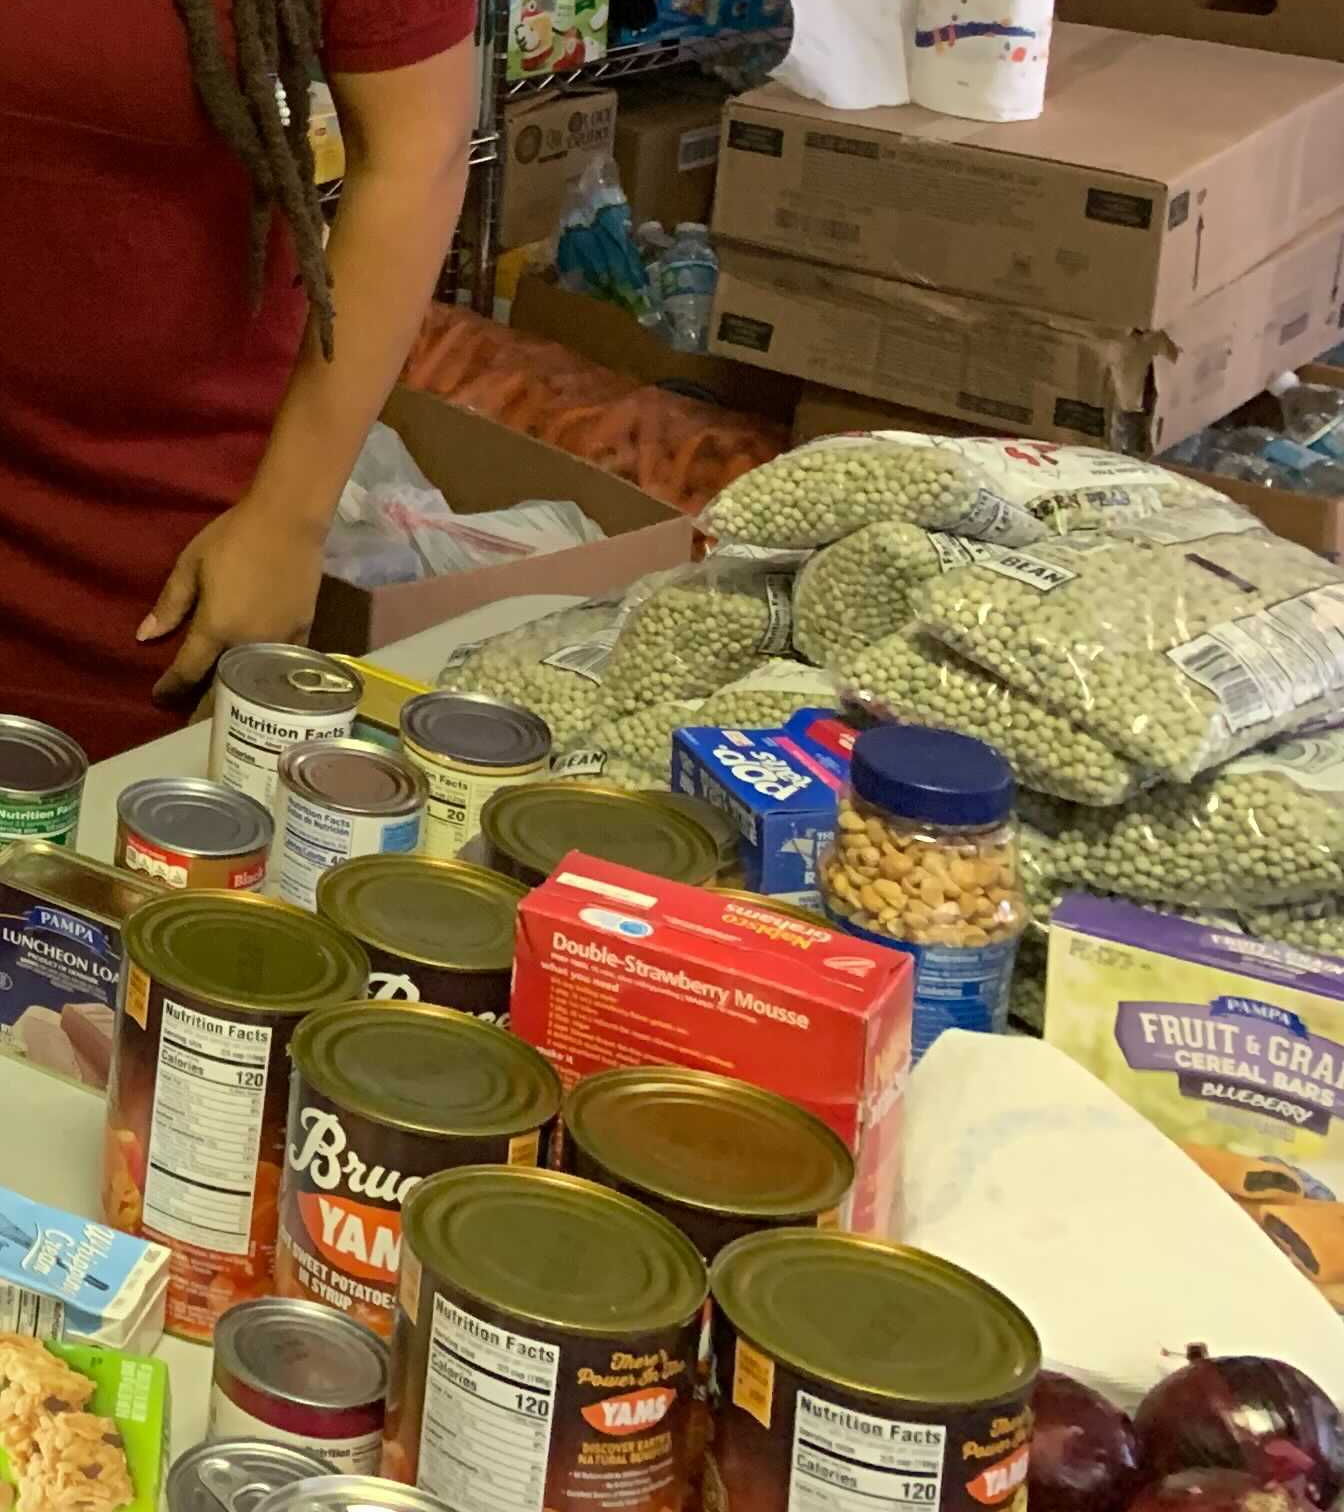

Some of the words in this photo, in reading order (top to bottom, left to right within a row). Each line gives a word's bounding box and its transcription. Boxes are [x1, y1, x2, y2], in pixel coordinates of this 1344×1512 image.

[230, 705, 299, 740] Nutrition
[305, 726, 345, 741] Facts
[439, 774, 469, 791] Facts
[323, 813, 351, 829] Facts
[446, 808, 465, 822] 20
[41, 911, 94, 943] PAMPA
[721, 914, 812, 951] Nabisco
[725, 902, 832, 944] Grahams
[2, 927, 89, 973] LUNCHEON
[540, 961, 567, 978] what
[570, 970, 587, 986] you
[589, 975, 620, 993] need
[552, 931, 730, 1007] Double-Strawberry
[734, 988, 811, 1030] Mousse
[165, 1002, 223, 1036] Nutrition
[228, 1026, 269, 1043] Facts
[1227, 997, 1291, 1026] PAMPA
[1140, 1012, 1240, 1055] FRUIT
[161, 1048, 204, 1076] Calories
[236, 1070, 263, 1088] 120
[1174, 1050, 1266, 1085] CEREAL
[1272, 1071, 1335, 1107] BARS
[1201, 1082, 1313, 1124] BLUEBERRY
[293, 1245, 330, 1284] SWEET
[298, 1268, 310, 1290] IN
[311, 1280, 352, 1313] SYRUP
[436, 1297, 500, 1346] Nutrition
[505, 1334, 555, 1364] Facts
[431, 1352, 477, 1393] Calories
[514, 1392, 549, 1418] 120
[600, 1393, 667, 1428] YAMS
[800, 1395, 883, 1436] Nutrition
[889, 1424, 942, 1446] Facts
[577, 1451, 627, 1466] NATURAL
[796, 1453, 857, 1488] Calories
[901, 1482, 936, 1501] 120
